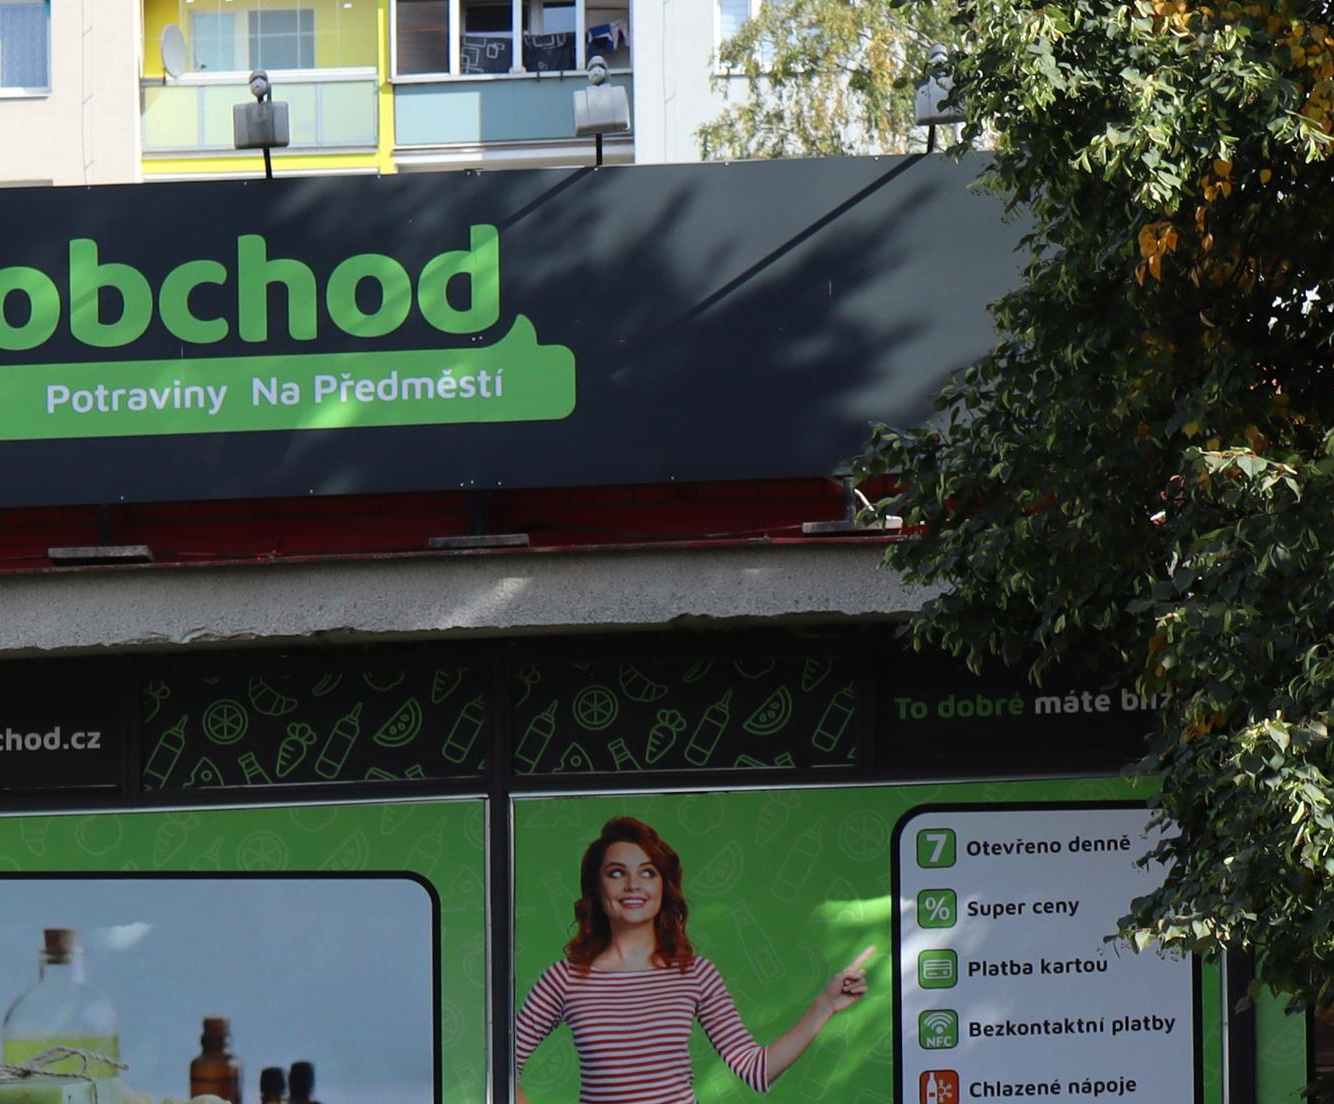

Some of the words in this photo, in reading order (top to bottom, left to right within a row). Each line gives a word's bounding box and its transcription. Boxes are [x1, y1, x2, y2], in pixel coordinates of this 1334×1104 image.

[46, 380, 228, 415] Potraviny
[252, 377, 300, 406] Na
[315, 368, 504, 404] Předměstí
[895, 697, 928, 720] To
[937, 693, 1024, 718] dobré
[1034, 690, 1111, 714] máte
[925, 833, 947, 863] 7
[966, 838, 1061, 856] Otevřeno
[1068, 834, 1131, 852] denně
[967, 901, 1026, 919] Super
[1032, 899, 1080, 916] ceny
[968, 960, 1033, 977] Platba
[1040, 957, 1108, 975] kartou
[969, 1017, 1104, 1037] Bezkontaktní
[1111, 1014, 1176, 1035] platby
[926, 1036, 952, 1048] NFC
[969, 1079, 1061, 1097] Chlazené
[1068, 1076, 1137, 1096] nápoje
